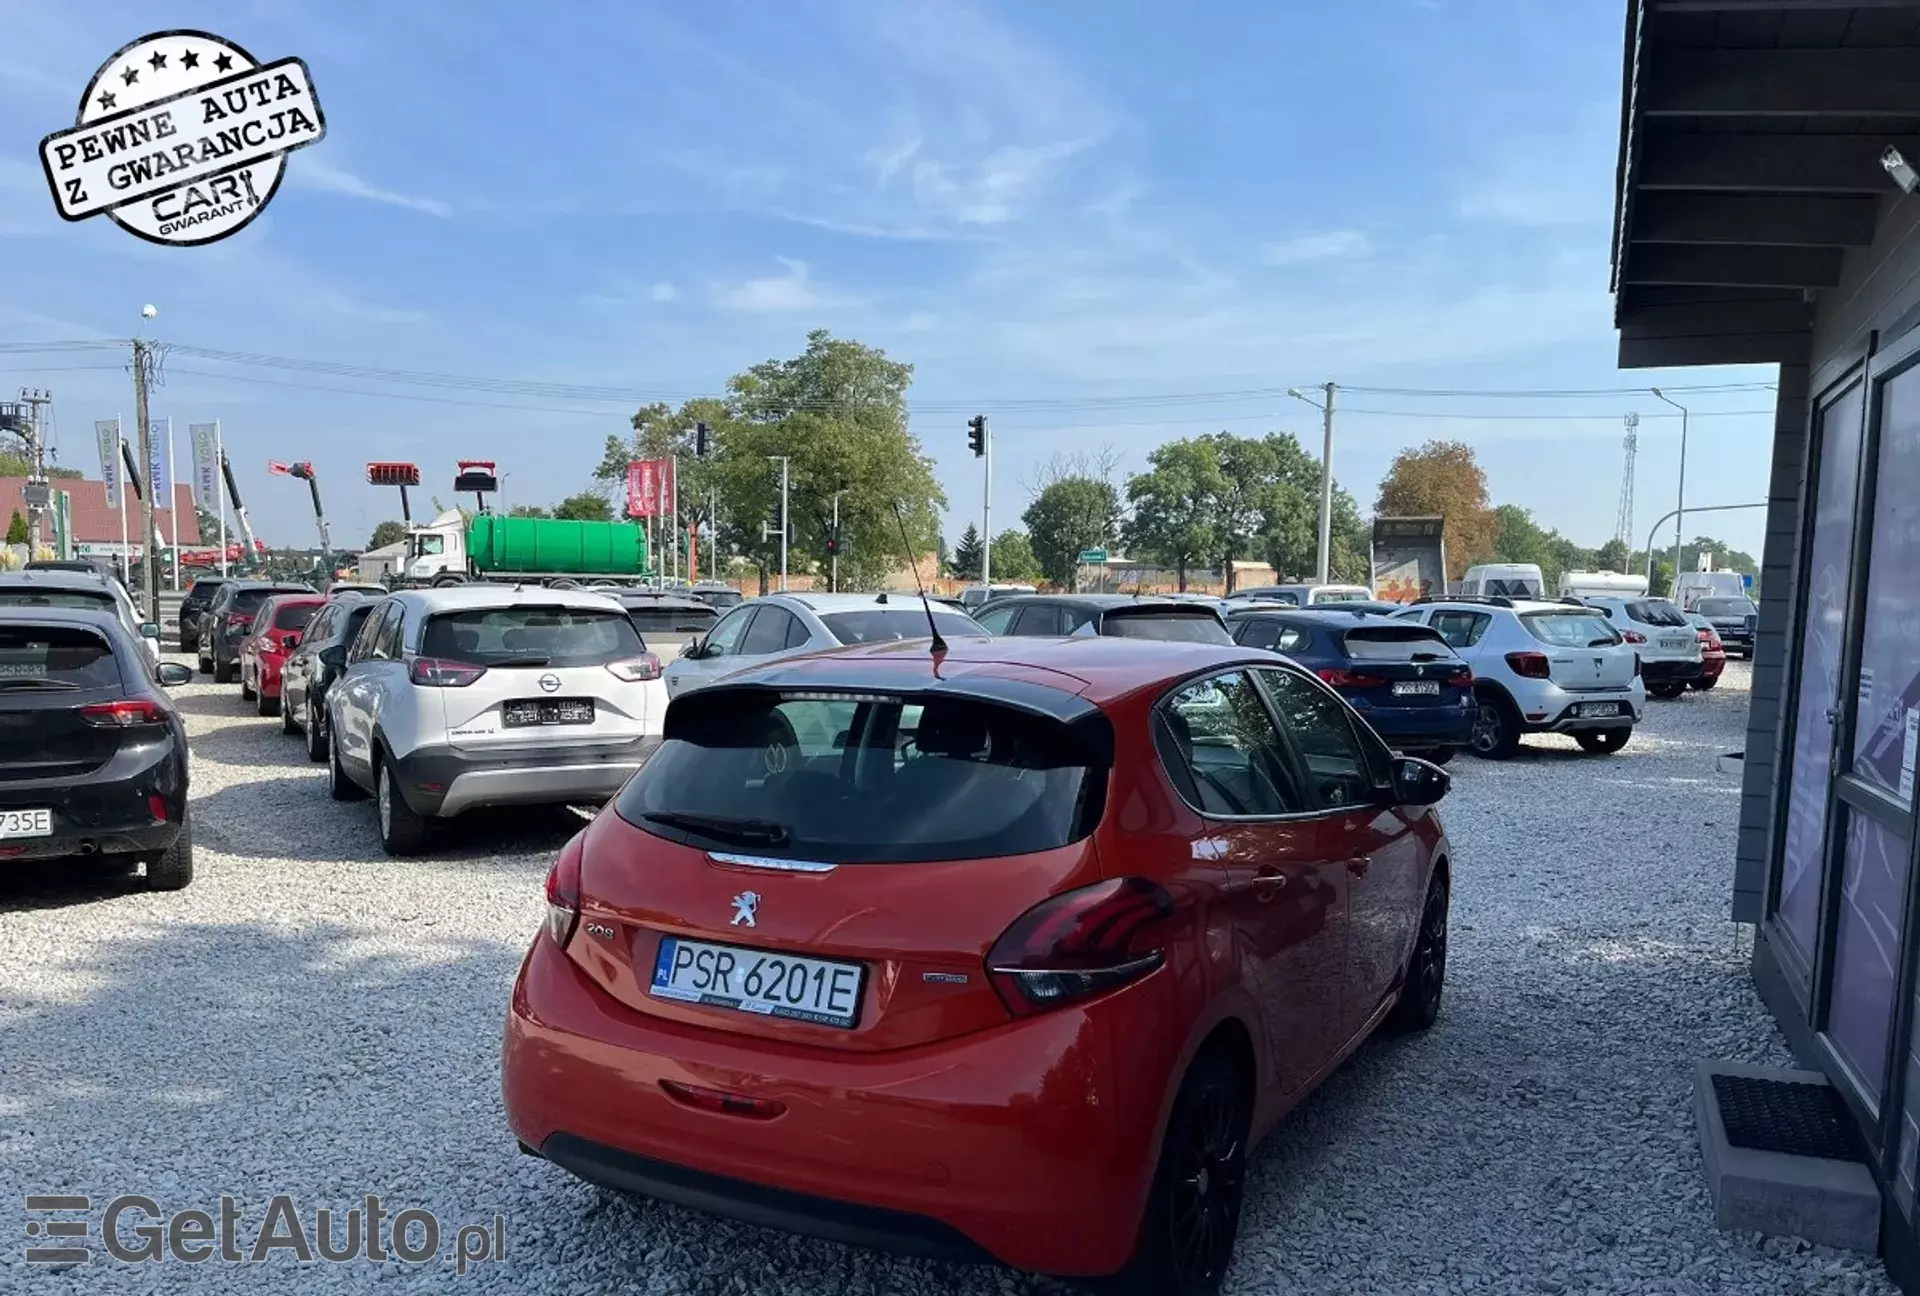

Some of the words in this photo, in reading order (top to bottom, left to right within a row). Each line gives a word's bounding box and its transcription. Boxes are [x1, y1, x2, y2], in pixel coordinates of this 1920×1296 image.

[656, 969, 669, 982] PL
[670, 945, 736, 994] PSR
[743, 957, 855, 1013] 6201E
